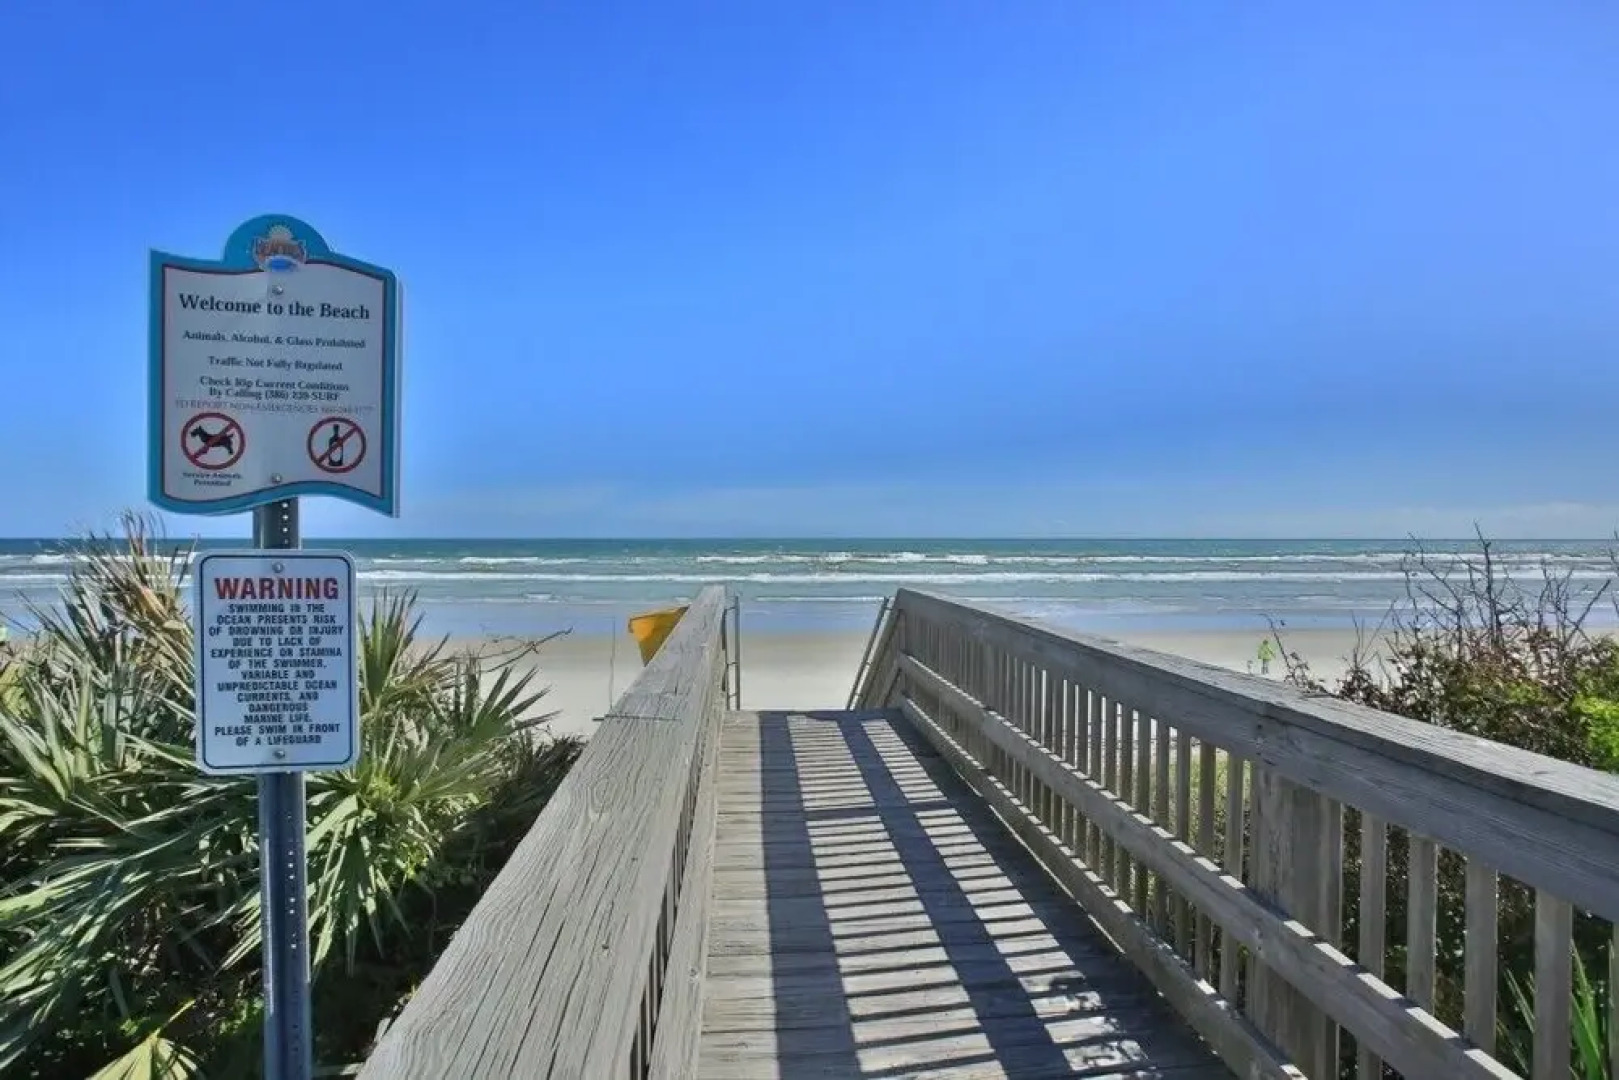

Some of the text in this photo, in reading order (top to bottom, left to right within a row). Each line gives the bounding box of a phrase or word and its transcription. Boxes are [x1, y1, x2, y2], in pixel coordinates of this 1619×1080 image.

[180, 293, 370, 320] Welcome to the Beach
[275, 336, 283, 344] &
[286, 336, 313, 346] Glass
[315, 338, 366, 348] Prohibited
[208, 356, 343, 372] Traffic Not Fully Regulated
[200, 375, 349, 391] Check Rip Current Conditions
[209, 387, 222, 398] By
[226, 388, 262, 400] Calling
[214, 577, 339, 600] WARNING
[228, 603, 325, 613] SWIMMING IS THE
[216, 614, 336, 626] OCEAN PRESENTS RISK
[209, 626, 344, 637] OF DROWNING OR INJURY
[232, 637, 322, 647] DUE TO LACK OF
[211, 648, 342, 658] EXPERIENCE OR STAMINA
[228, 659, 241, 670] OF
[248, 659, 267, 669] THE
[241, 669, 315, 680] VARIABLE AND
[217, 680, 338, 692] UNPREDICTABLE OCEAN
[299, 691, 319, 701] AND
[248, 703, 308, 713] DANGEROUS
[243, 714, 283, 723] MARINE
[214, 723, 341, 736] PLEASE SWIM IN FRONT
[235, 735, 322, 747] OF A LIFEGUARD
